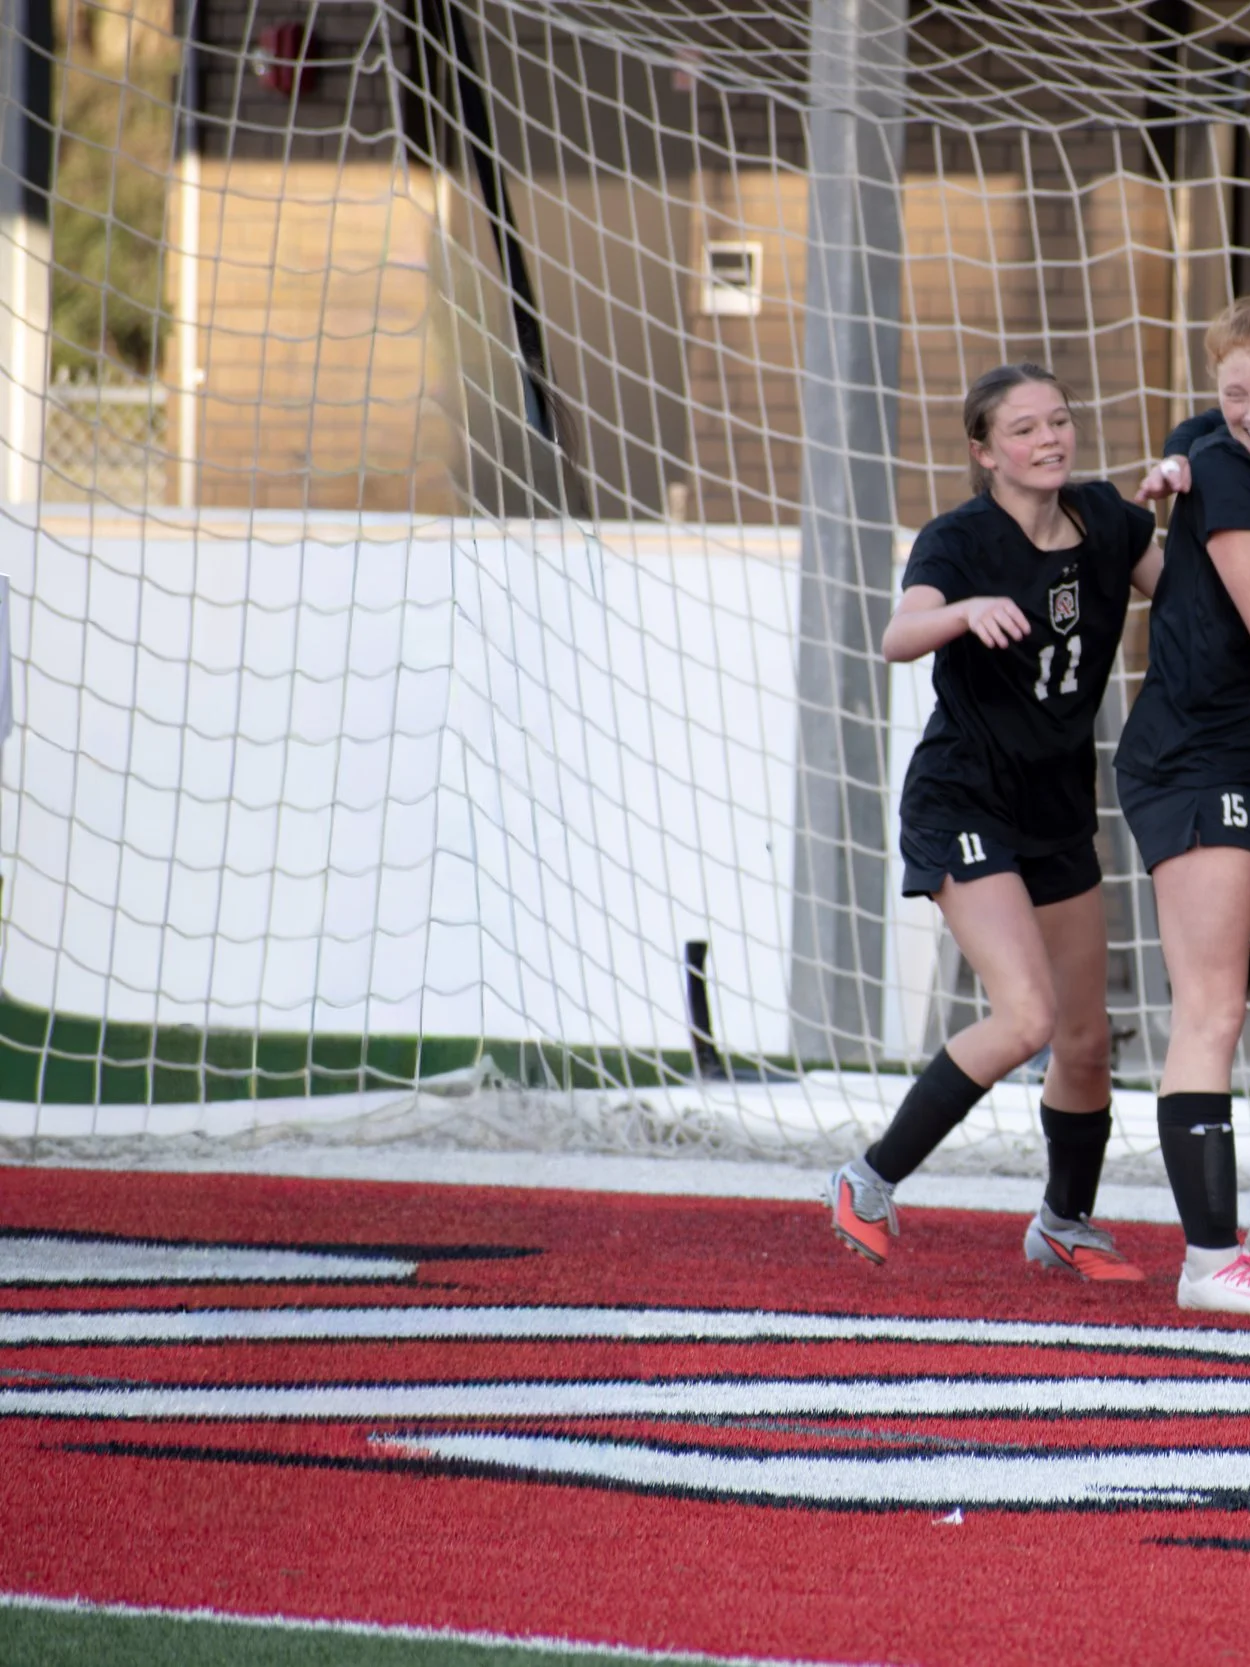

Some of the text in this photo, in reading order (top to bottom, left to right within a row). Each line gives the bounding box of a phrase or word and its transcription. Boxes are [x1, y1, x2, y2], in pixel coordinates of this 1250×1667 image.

[1034, 634, 1082, 701] 11
[1221, 792, 1249, 828] 15
[958, 832, 987, 865] 11
